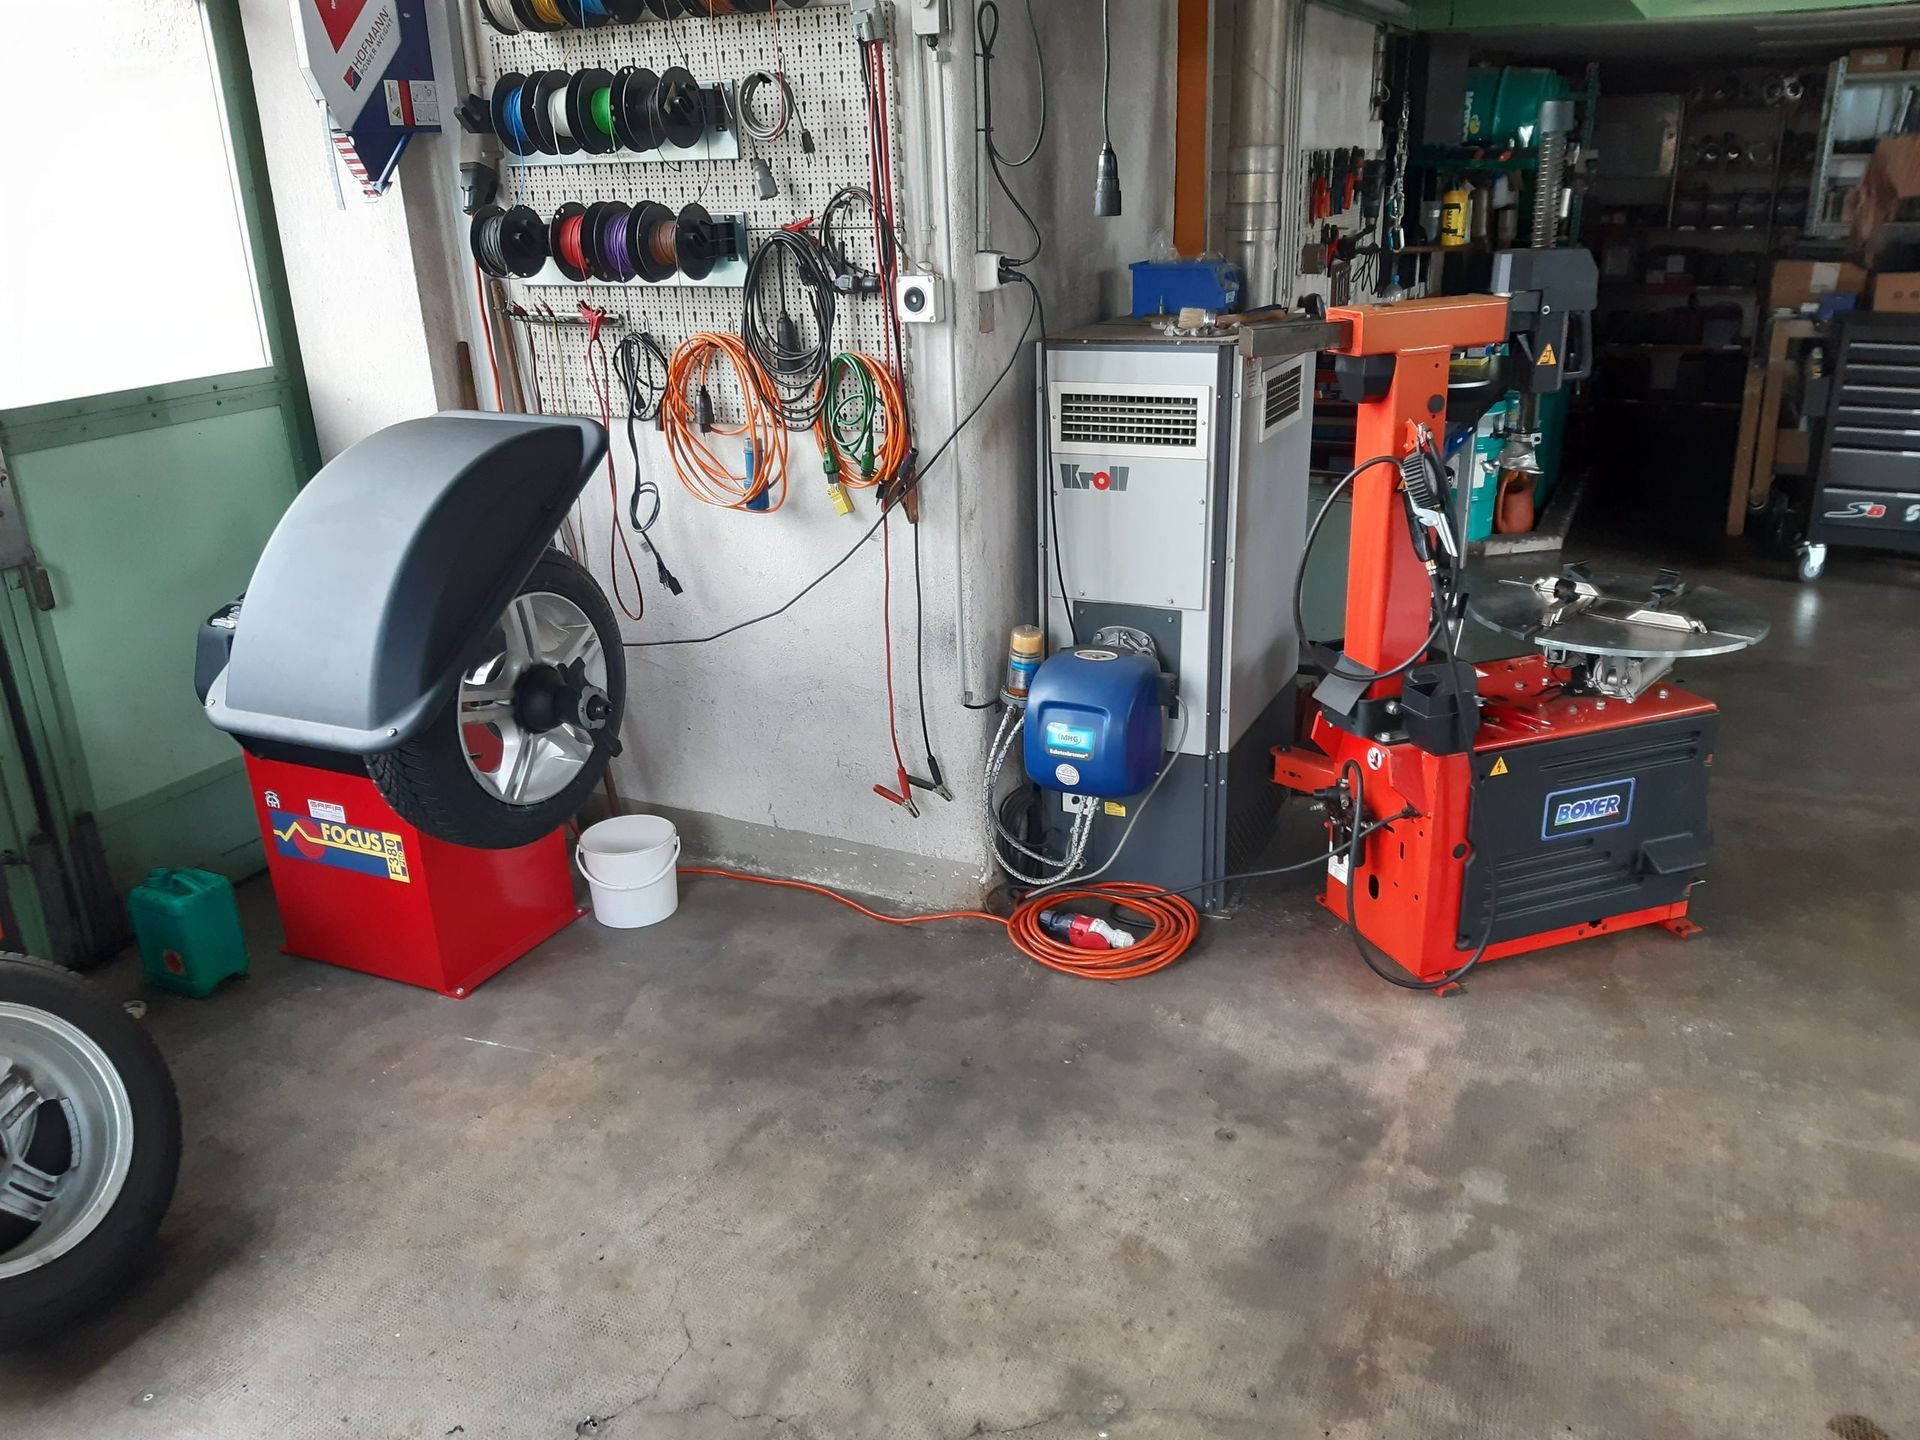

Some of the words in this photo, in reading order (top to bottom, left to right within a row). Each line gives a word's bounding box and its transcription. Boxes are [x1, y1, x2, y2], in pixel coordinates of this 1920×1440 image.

[352, 8, 389, 70] HOFMANN
[360, 48, 377, 76] POWER
[376, 17, 394, 47] WEIGHT
[1060, 463, 1130, 492] Kroll
[1060, 734, 1079, 743] MHG
[1555, 795, 1621, 825] BOXER
[320, 823, 382, 851] FOCUS
[386, 839, 401, 876] F380
